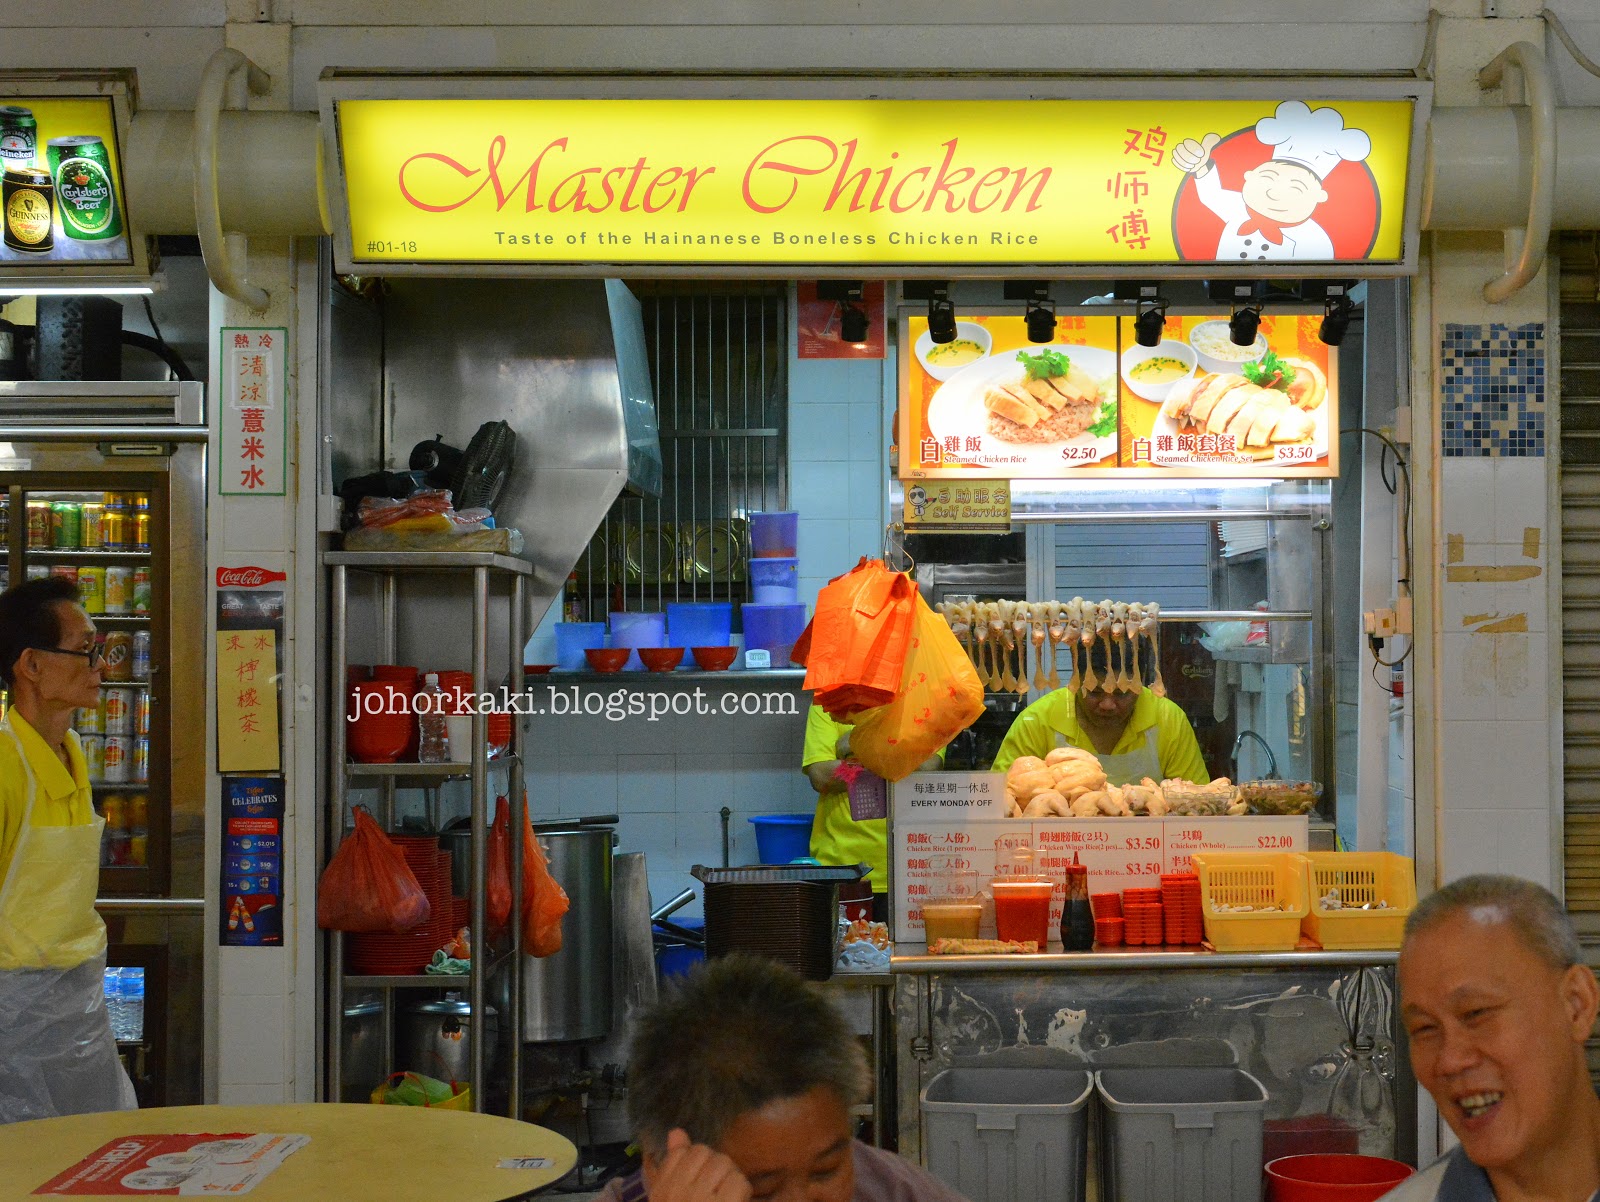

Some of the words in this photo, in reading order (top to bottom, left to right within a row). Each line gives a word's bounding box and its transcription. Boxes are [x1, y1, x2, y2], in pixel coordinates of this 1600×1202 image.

[398, 134, 716, 213] Master
[742, 135, 1053, 214] Chicken
[61, 182, 108, 200] Carlsberg
[1106, 125, 1168, 250] 鸡师傅
[76, 200, 101, 210] Beer
[10, 207, 49, 221] GUINNESS
[494, 231, 554, 246] Taste
[566, 231, 588, 246] of
[598, 231, 631, 246] the
[644, 231, 761, 246] Hainanese
[773, 231, 877, 246] Boneless
[888, 231, 979, 246] Chicken
[990, 231, 1039, 246] Rice
[367, 240, 417, 254] #01-18
[943, 455, 977, 464] Steamed
[978, 455, 1009, 464] Chicken
[1010, 455, 1027, 463] Rice
[1061, 447, 1097, 460] $2.50
[1156, 455, 1189, 463] Steamed
[1190, 455, 1220, 463] Chicken
[1240, 455, 1254, 463] Set
[1277, 446, 1314, 460] $3.50
[933, 505, 959, 520] Self
[962, 506, 1008, 518] Service
[914, 782, 990, 794] 每逢星期一休息
[231, 794, 278, 806] CELEBRATES
[911, 799, 938, 807] EVERY
[939, 799, 975, 807] MONDAY
[977, 799, 993, 807] OFF
[1066, 844, 1084, 852] Wings
[1125, 837, 1160, 850] $3.50
[1170, 842, 1198, 850] Chicken
[1199, 842, 1226, 850] (Whole)
[1257, 835, 1293, 849] $22.00
[954, 845, 977, 853] person)
[1126, 862, 1160, 876] $3.50
